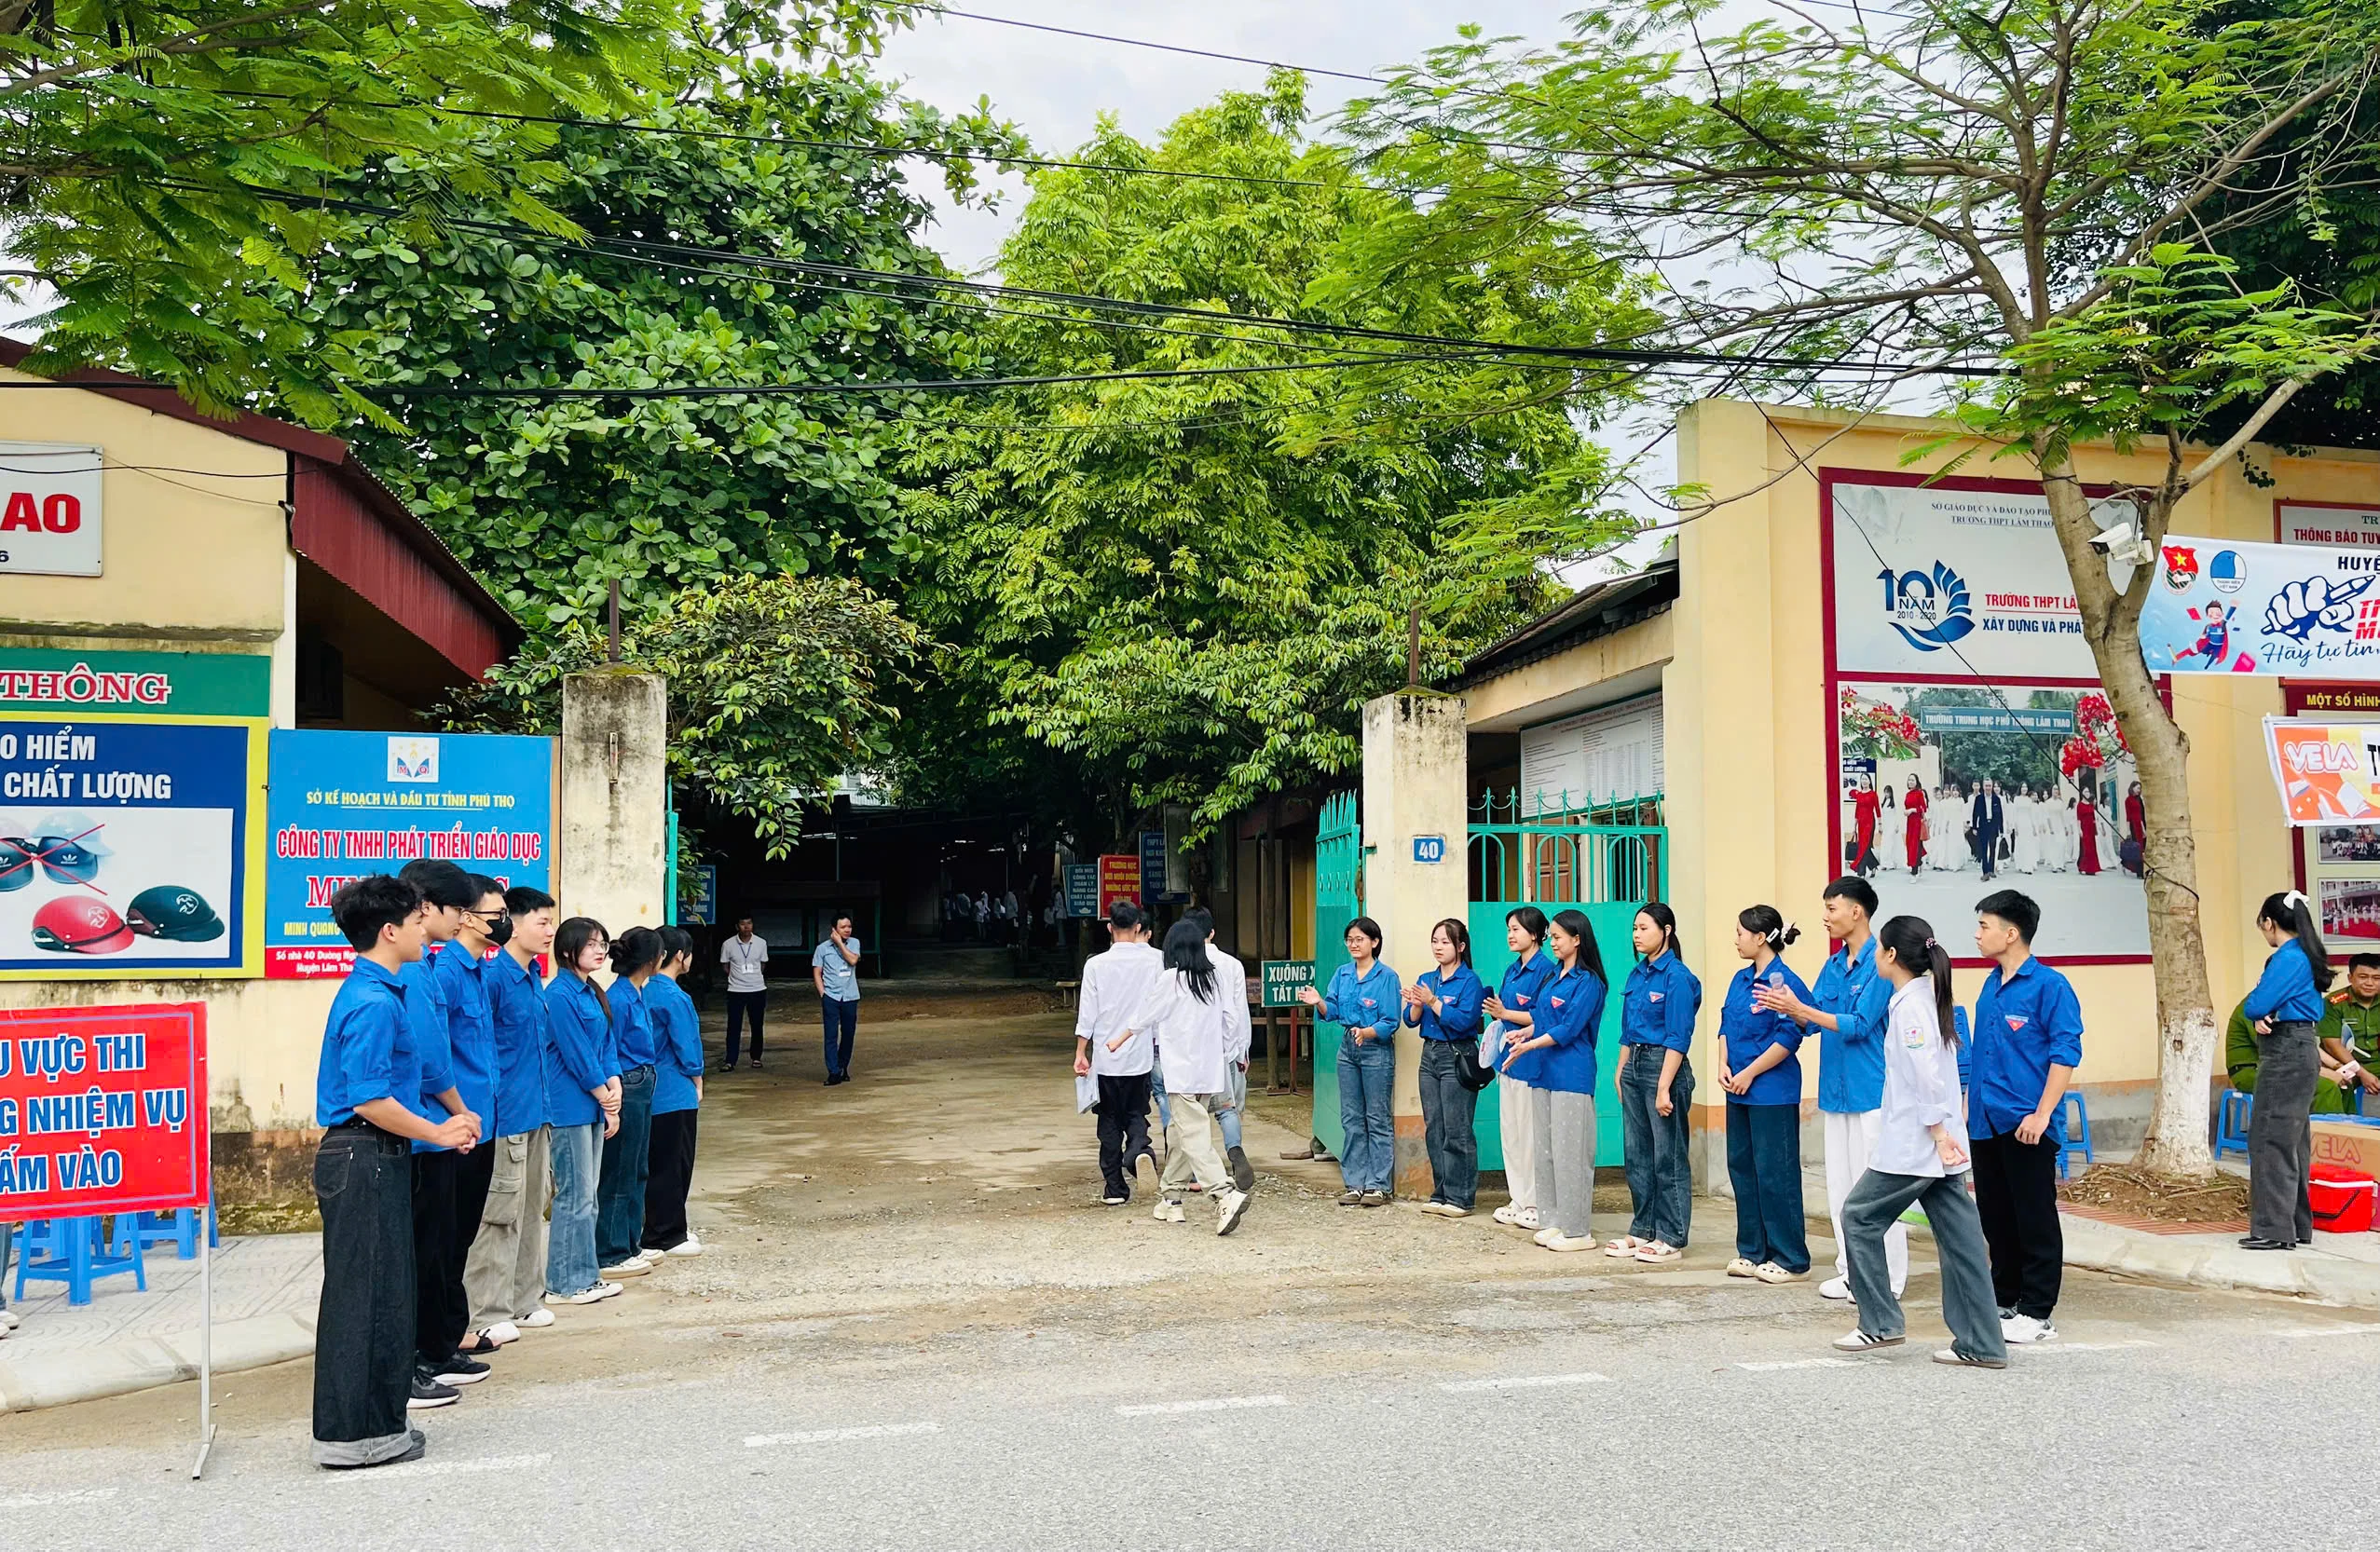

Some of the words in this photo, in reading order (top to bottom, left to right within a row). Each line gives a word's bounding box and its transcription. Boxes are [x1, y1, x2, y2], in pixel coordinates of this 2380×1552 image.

[0, 492, 81, 534] AO
[1989, 516, 2010, 526] THPT
[2031, 519, 2054, 528] THAO
[2293, 527, 2332, 542] THÔNG
[2335, 528, 2358, 543] BÁO
[1876, 568, 1935, 611] 10
[1898, 596, 1935, 610] NĂM
[1985, 591, 2030, 607] TRƯỜNG
[2033, 595, 2060, 608] THPT
[2063, 594, 2079, 610] LÂ
[1897, 610, 1914, 619] 2010
[1920, 611, 1937, 621] 2020
[1983, 616, 2005, 632] XÂY
[2008, 619, 2039, 635] DỰNG
[2042, 619, 2058, 633] VÀ
[2356, 620, 2380, 640] M
[2261, 642, 2314, 668] Hãy
[2316, 640, 2341, 661] tự
[0, 662, 172, 704] THÔNG
[2306, 692, 2332, 709] MỘT
[2335, 691, 2351, 707] SỐ
[26, 725, 96, 760] HIỂM
[2284, 742, 2359, 773] VELA
[4, 764, 75, 798] CHẤT
[82, 771, 171, 804] LƯỢNG
[306, 790, 322, 805] SỞ
[324, 789, 339, 805] KẾ
[341, 793, 380, 808] HOẠCH
[383, 790, 398, 806] VÀ
[425, 793, 439, 807] TƯ
[469, 792, 491, 808] PHÚ
[493, 795, 515, 810] THỌ
[277, 824, 320, 858] CÔNG
[323, 831, 340, 858] TY
[344, 831, 384, 858] TNHH
[388, 825, 426, 859] PHÁT
[429, 822, 471, 859] TRIỂN
[474, 826, 508, 860] GIÁO
[512, 832, 540, 866] DỤC
[1418, 841, 1439, 859] 40
[303, 950, 315, 960] 40
[1272, 981, 1293, 1002] TẮT
[20, 1033, 86, 1082] VỰC
[93, 1033, 146, 1072] THI
[27, 1085, 137, 1138] NHIỆM
[143, 1088, 187, 1134] VỤ
[57, 1144, 123, 1191] VÀO
